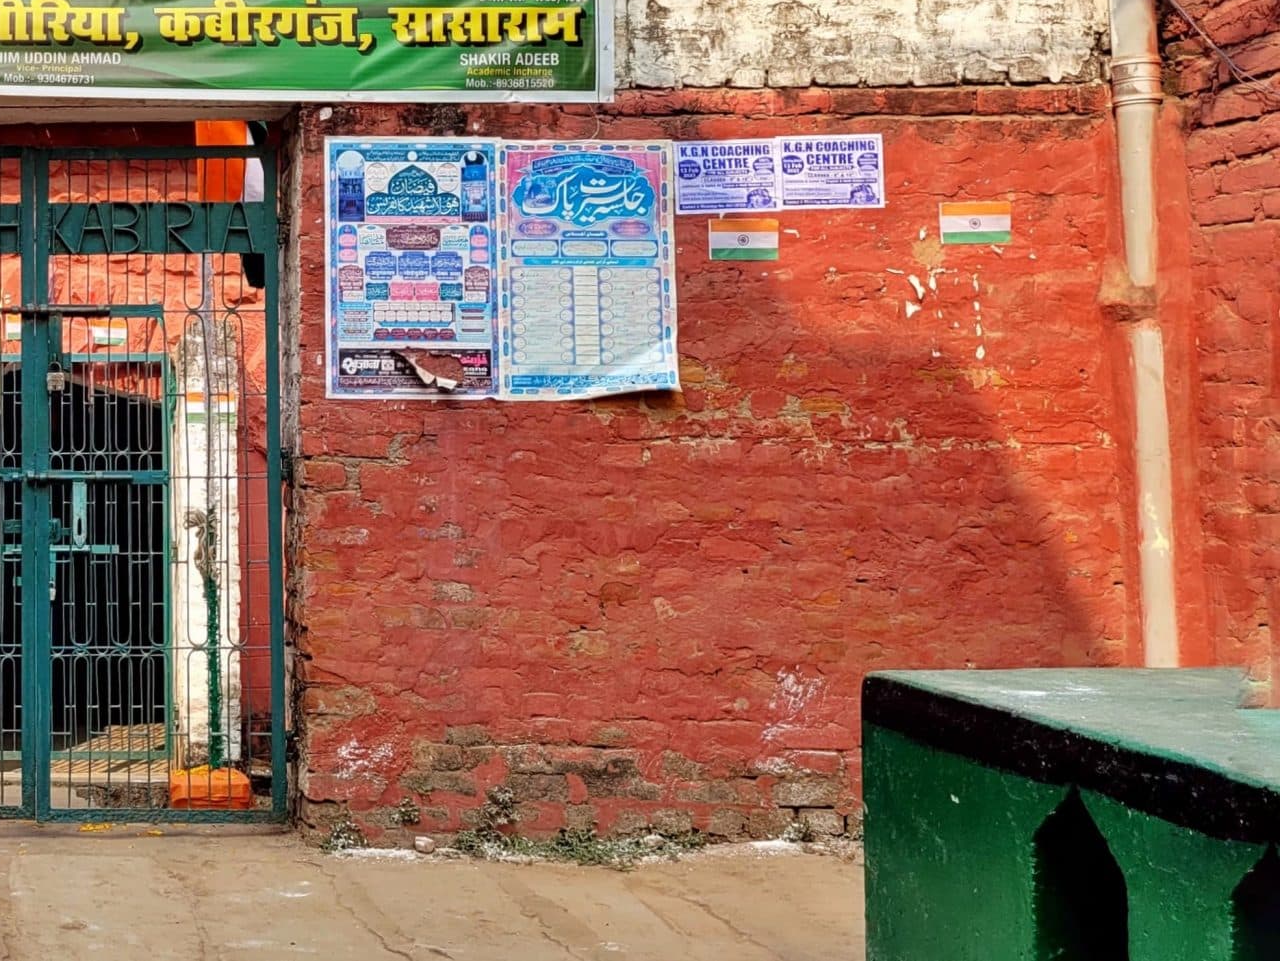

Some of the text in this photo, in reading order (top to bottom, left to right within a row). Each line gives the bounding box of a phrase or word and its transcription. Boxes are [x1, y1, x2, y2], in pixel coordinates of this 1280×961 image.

[387, 6, 582, 43] सासाराम
[24, 52, 67, 64] UDDIN
[71, 52, 122, 65] AHMAD
[460, 53, 560, 66] SHAKIR ADEEB
[42, 64, 82, 74] Principal
[467, 66, 553, 79] Academic Incharge
[680, 144, 770, 157] K.G.N COACHING
[784, 140, 875, 152] K.G.N COACHING
[703, 158, 750, 169] CENTRE
[806, 153, 854, 165] CENTRE
[52, 201, 254, 253] KABIRIA
